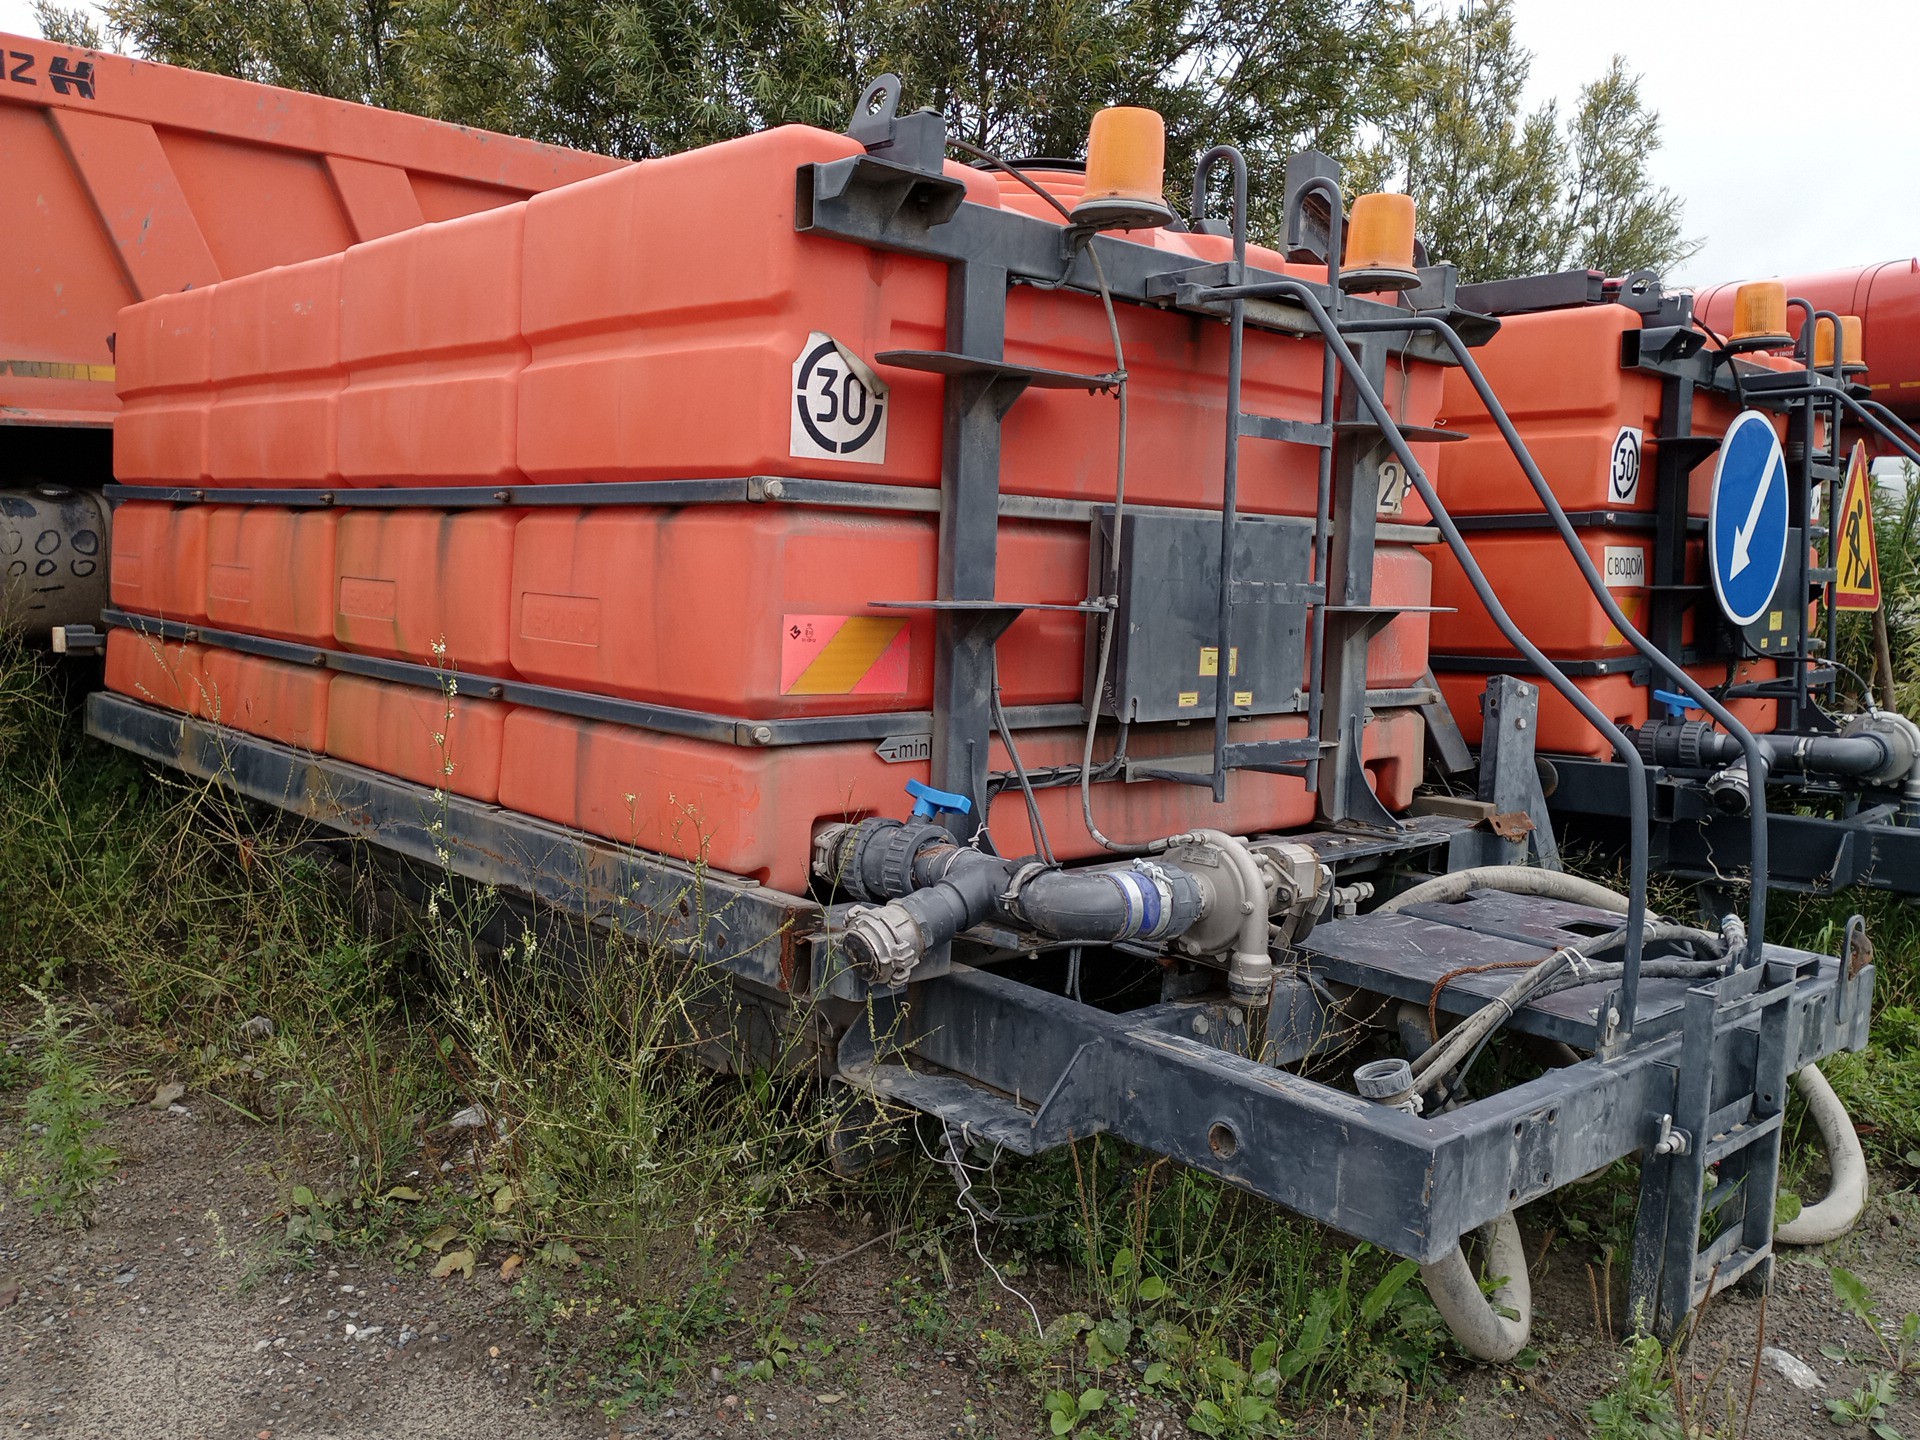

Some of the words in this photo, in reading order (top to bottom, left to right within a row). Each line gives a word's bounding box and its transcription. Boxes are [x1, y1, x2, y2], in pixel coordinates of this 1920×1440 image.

[816, 367, 867, 426] 30
[1618, 448, 1635, 482] 30
[1607, 557, 1613, 576] С
[1614, 554, 1643, 579] ВОДОЙ
[899, 739, 928, 758] min
